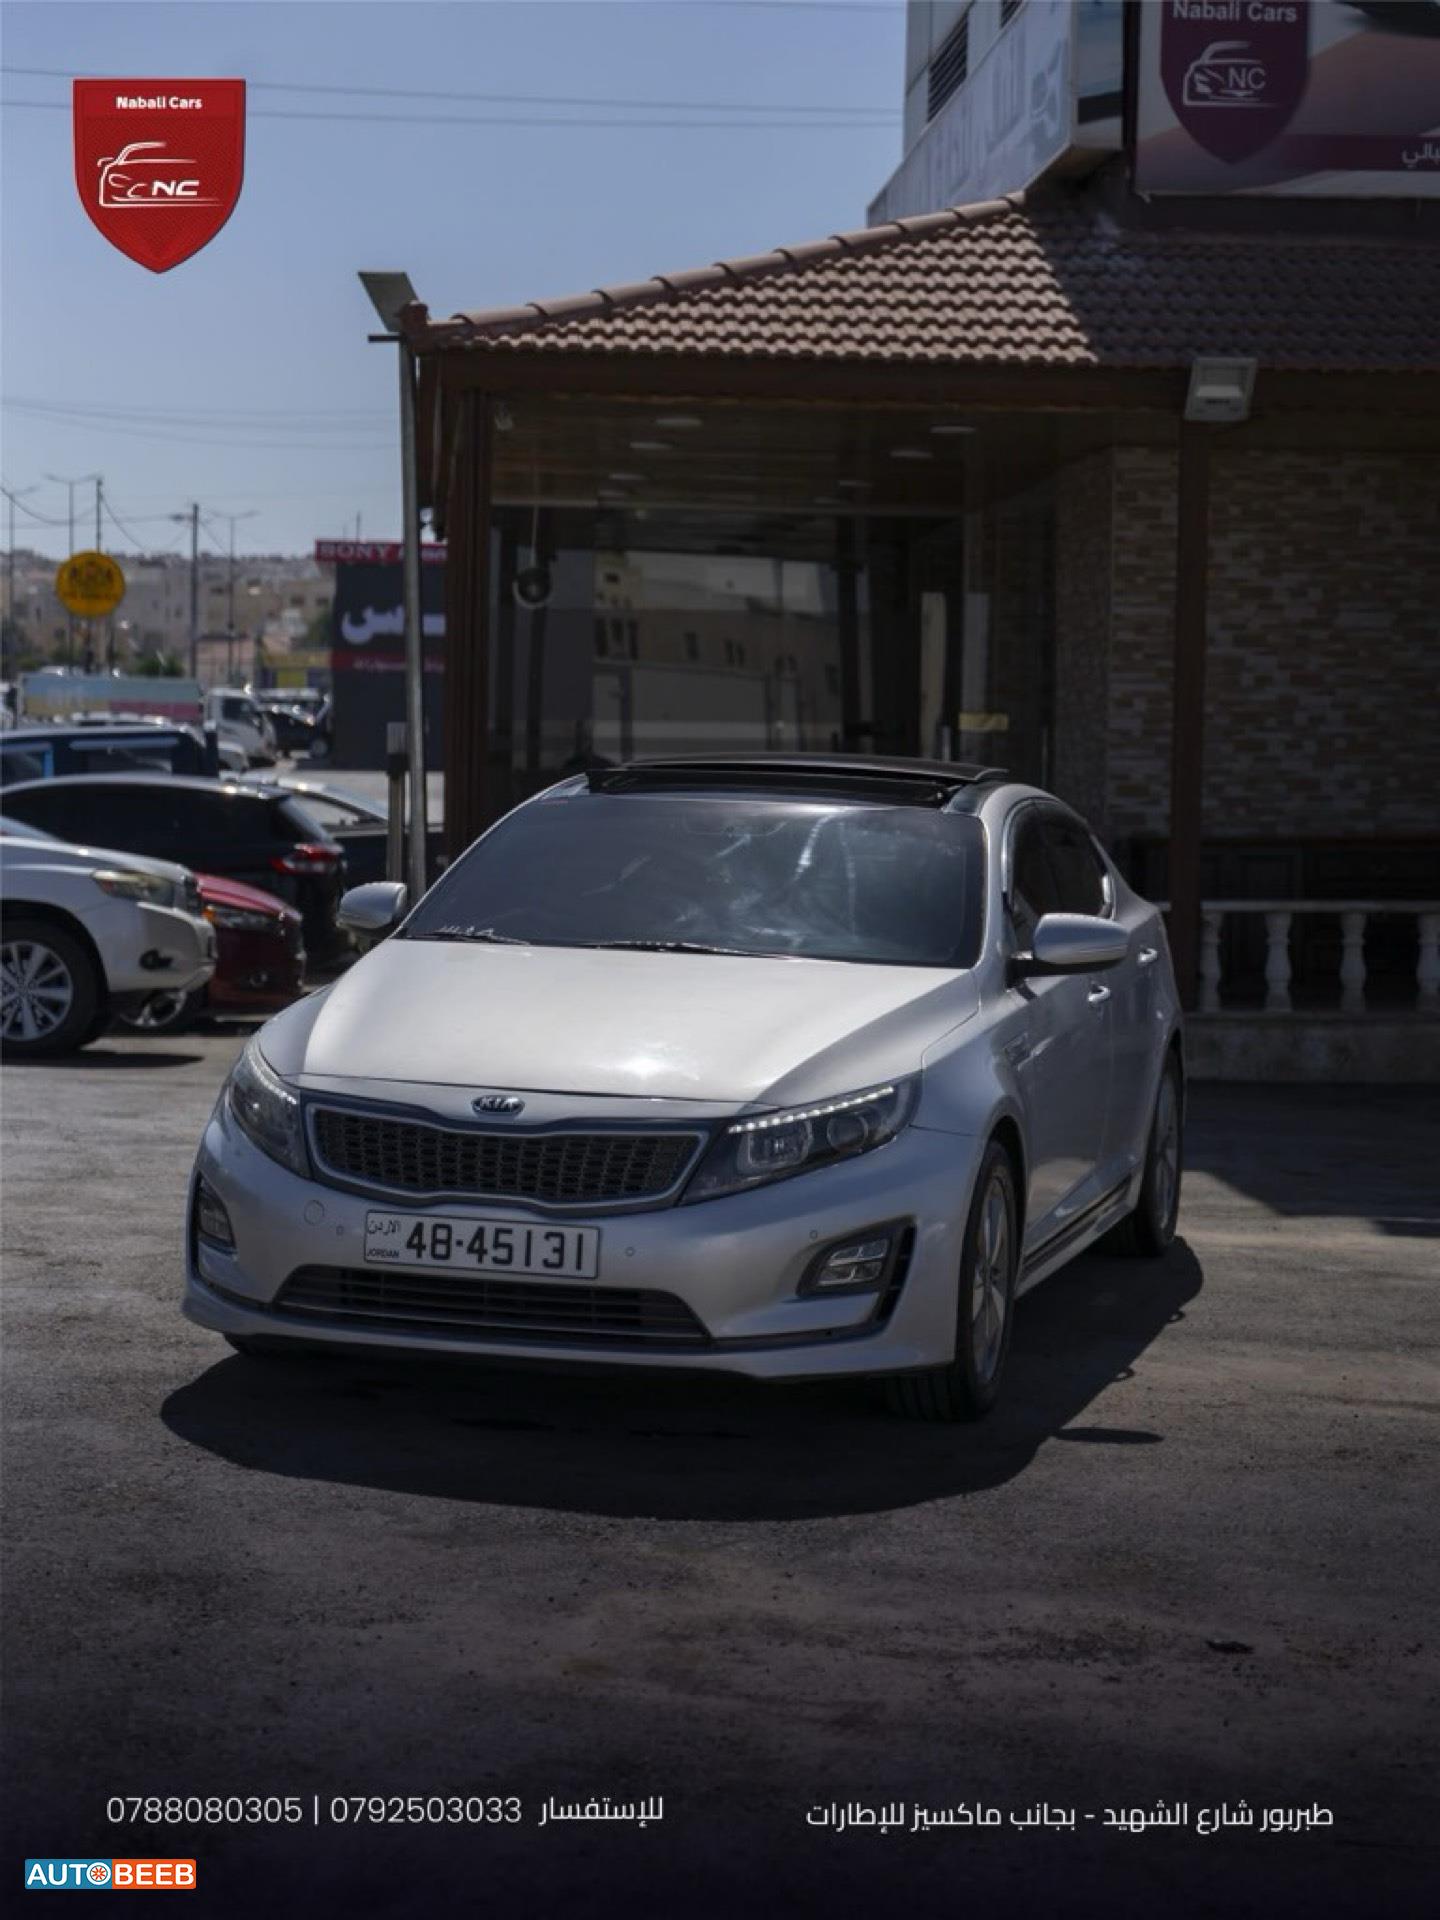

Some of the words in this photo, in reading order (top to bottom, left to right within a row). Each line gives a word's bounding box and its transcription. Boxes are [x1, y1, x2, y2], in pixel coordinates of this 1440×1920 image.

[1172, 0, 1239, 20] Nabali
[1246, 2, 1298, 23] Cars
[1228, 67, 1267, 90] NC
[366, 1247, 400, 1259] JORDAN
